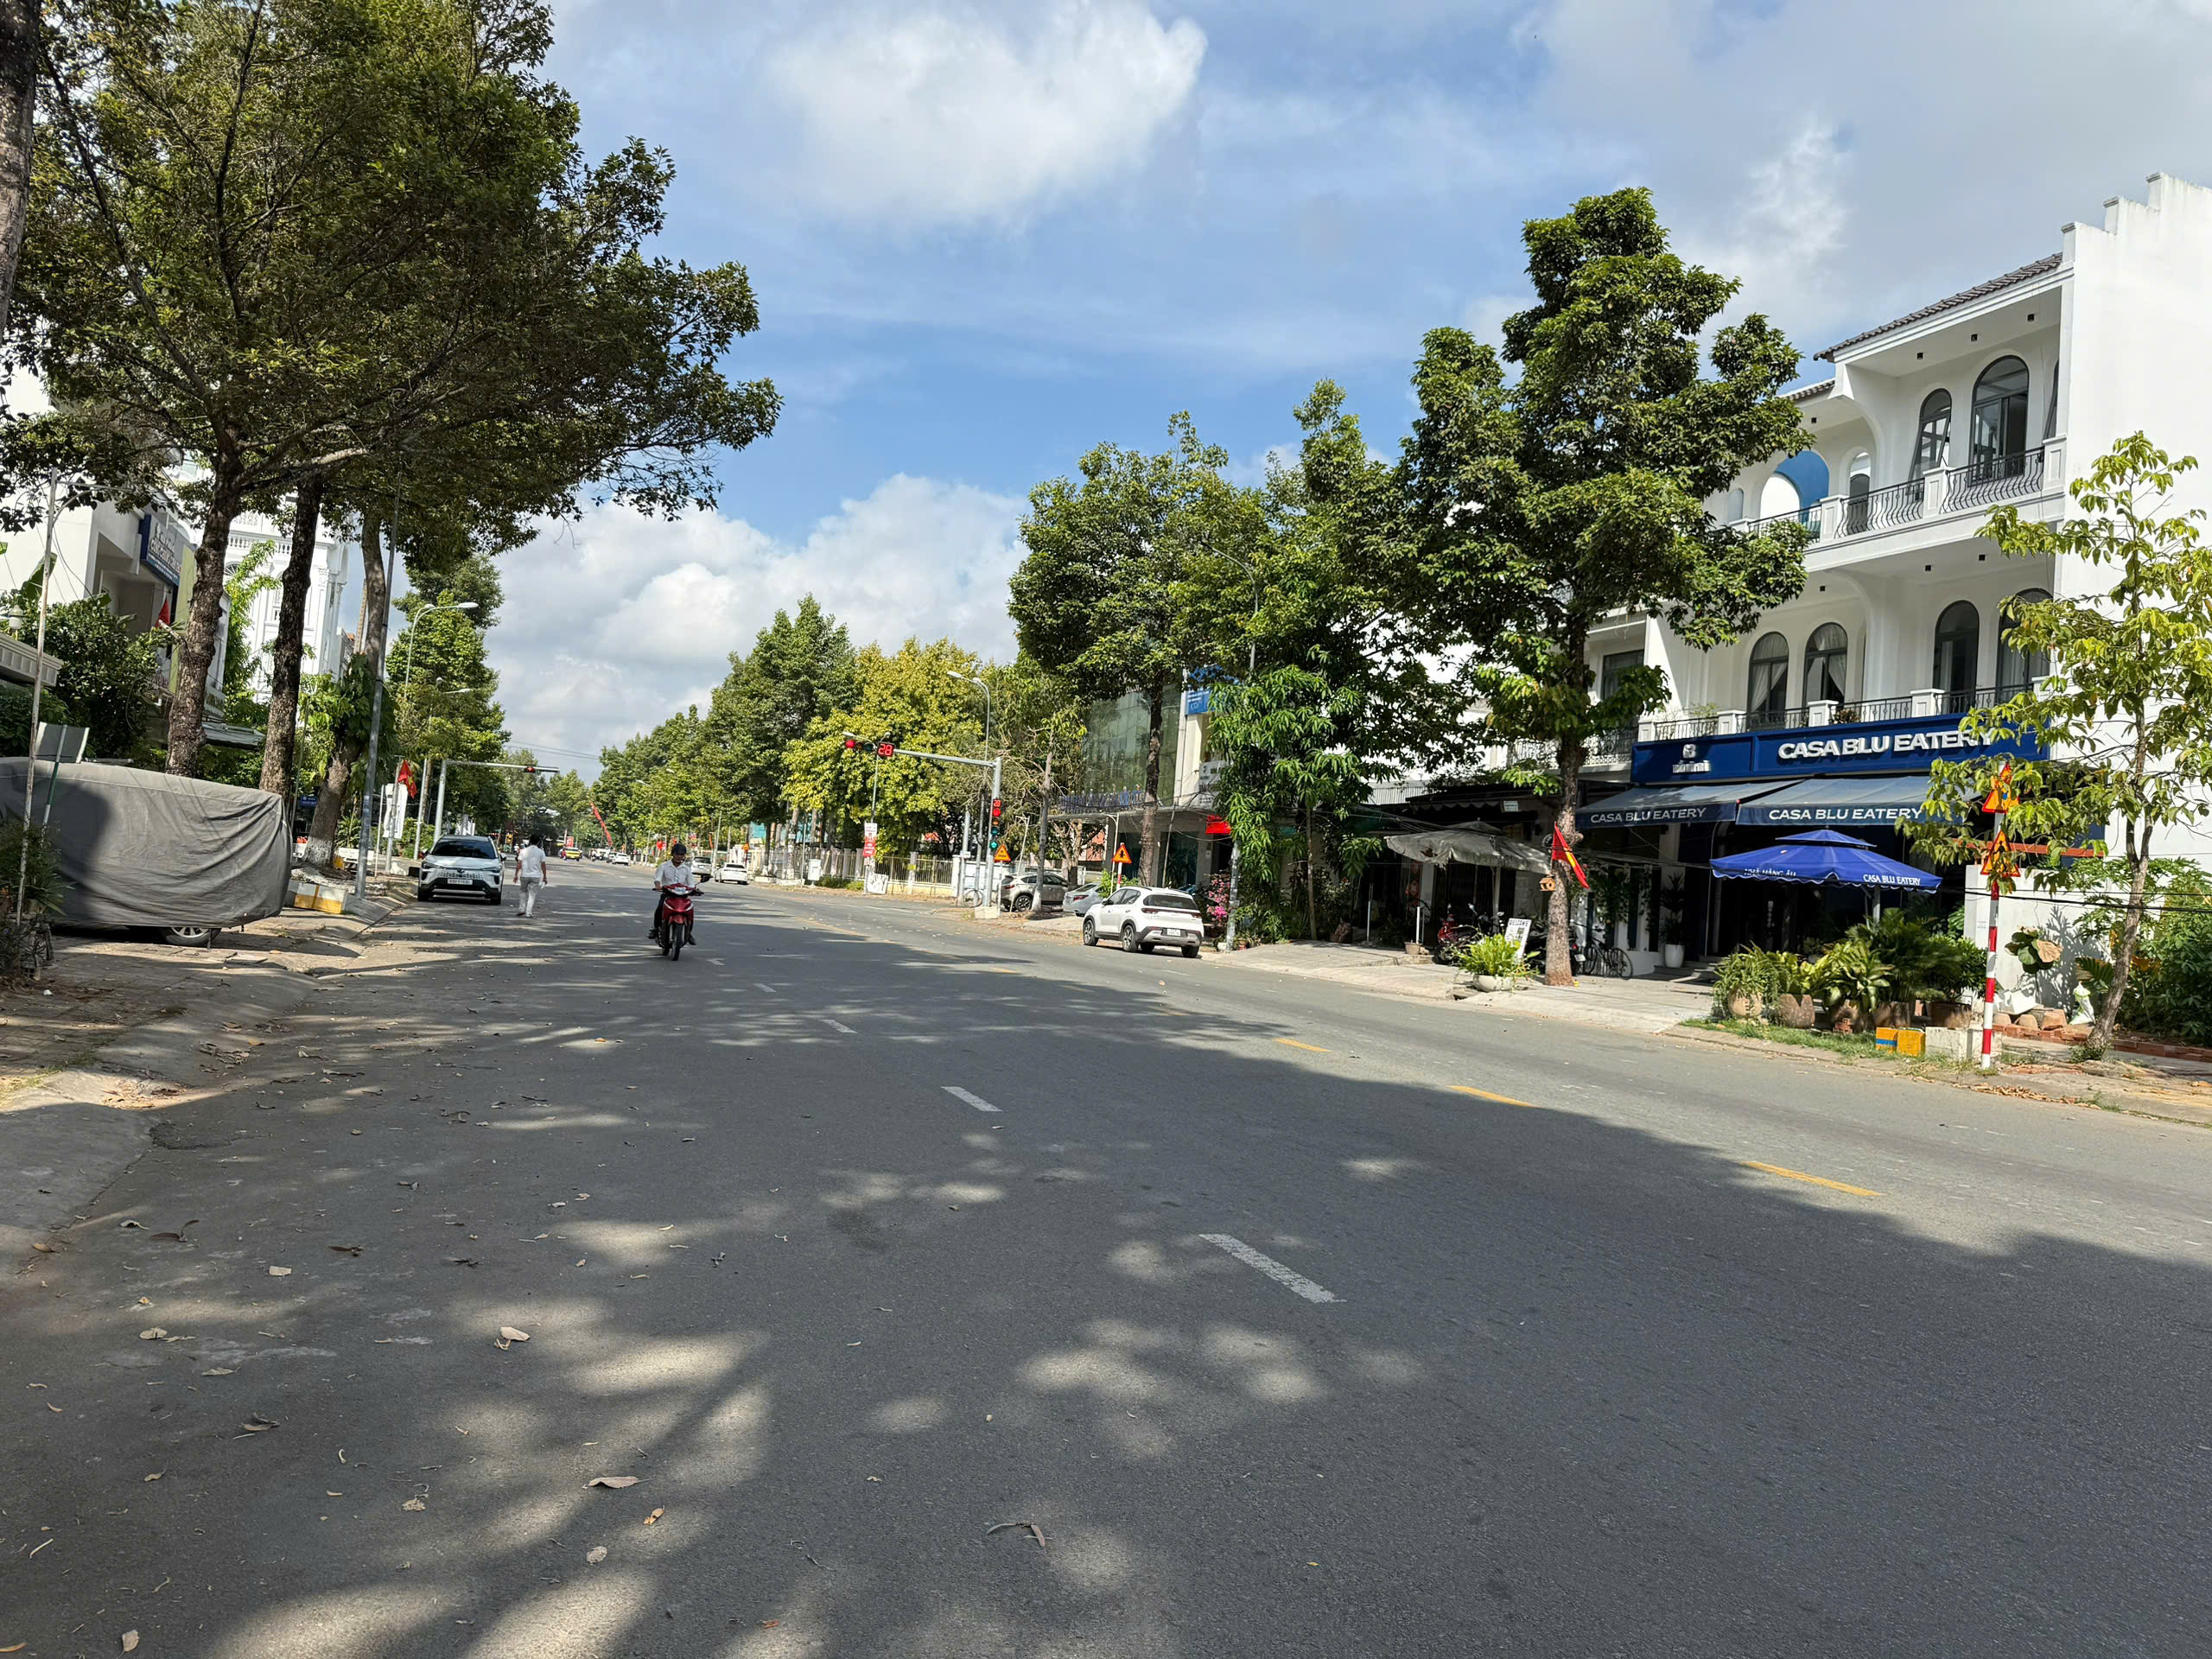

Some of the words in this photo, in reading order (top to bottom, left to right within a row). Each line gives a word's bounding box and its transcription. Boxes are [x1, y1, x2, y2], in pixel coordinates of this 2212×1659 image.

[878, 743, 893, 756] 28
[1777, 740, 1840, 760] CASA
[1842, 734, 1891, 756] BLU
[1894, 728, 1993, 753] EATERY
[1590, 813, 1623, 823] CASA
[1625, 811, 1651, 822] BLU
[1653, 808, 1707, 820] EATERY
[1769, 809, 1812, 820] CASA
[1815, 809, 1848, 820] BLU
[1852, 808, 1923, 820] EATERY
[1863, 874, 1881, 884] CASA
[1882, 875, 1896, 885] BLU
[1897, 877, 1921, 887] EATERY
